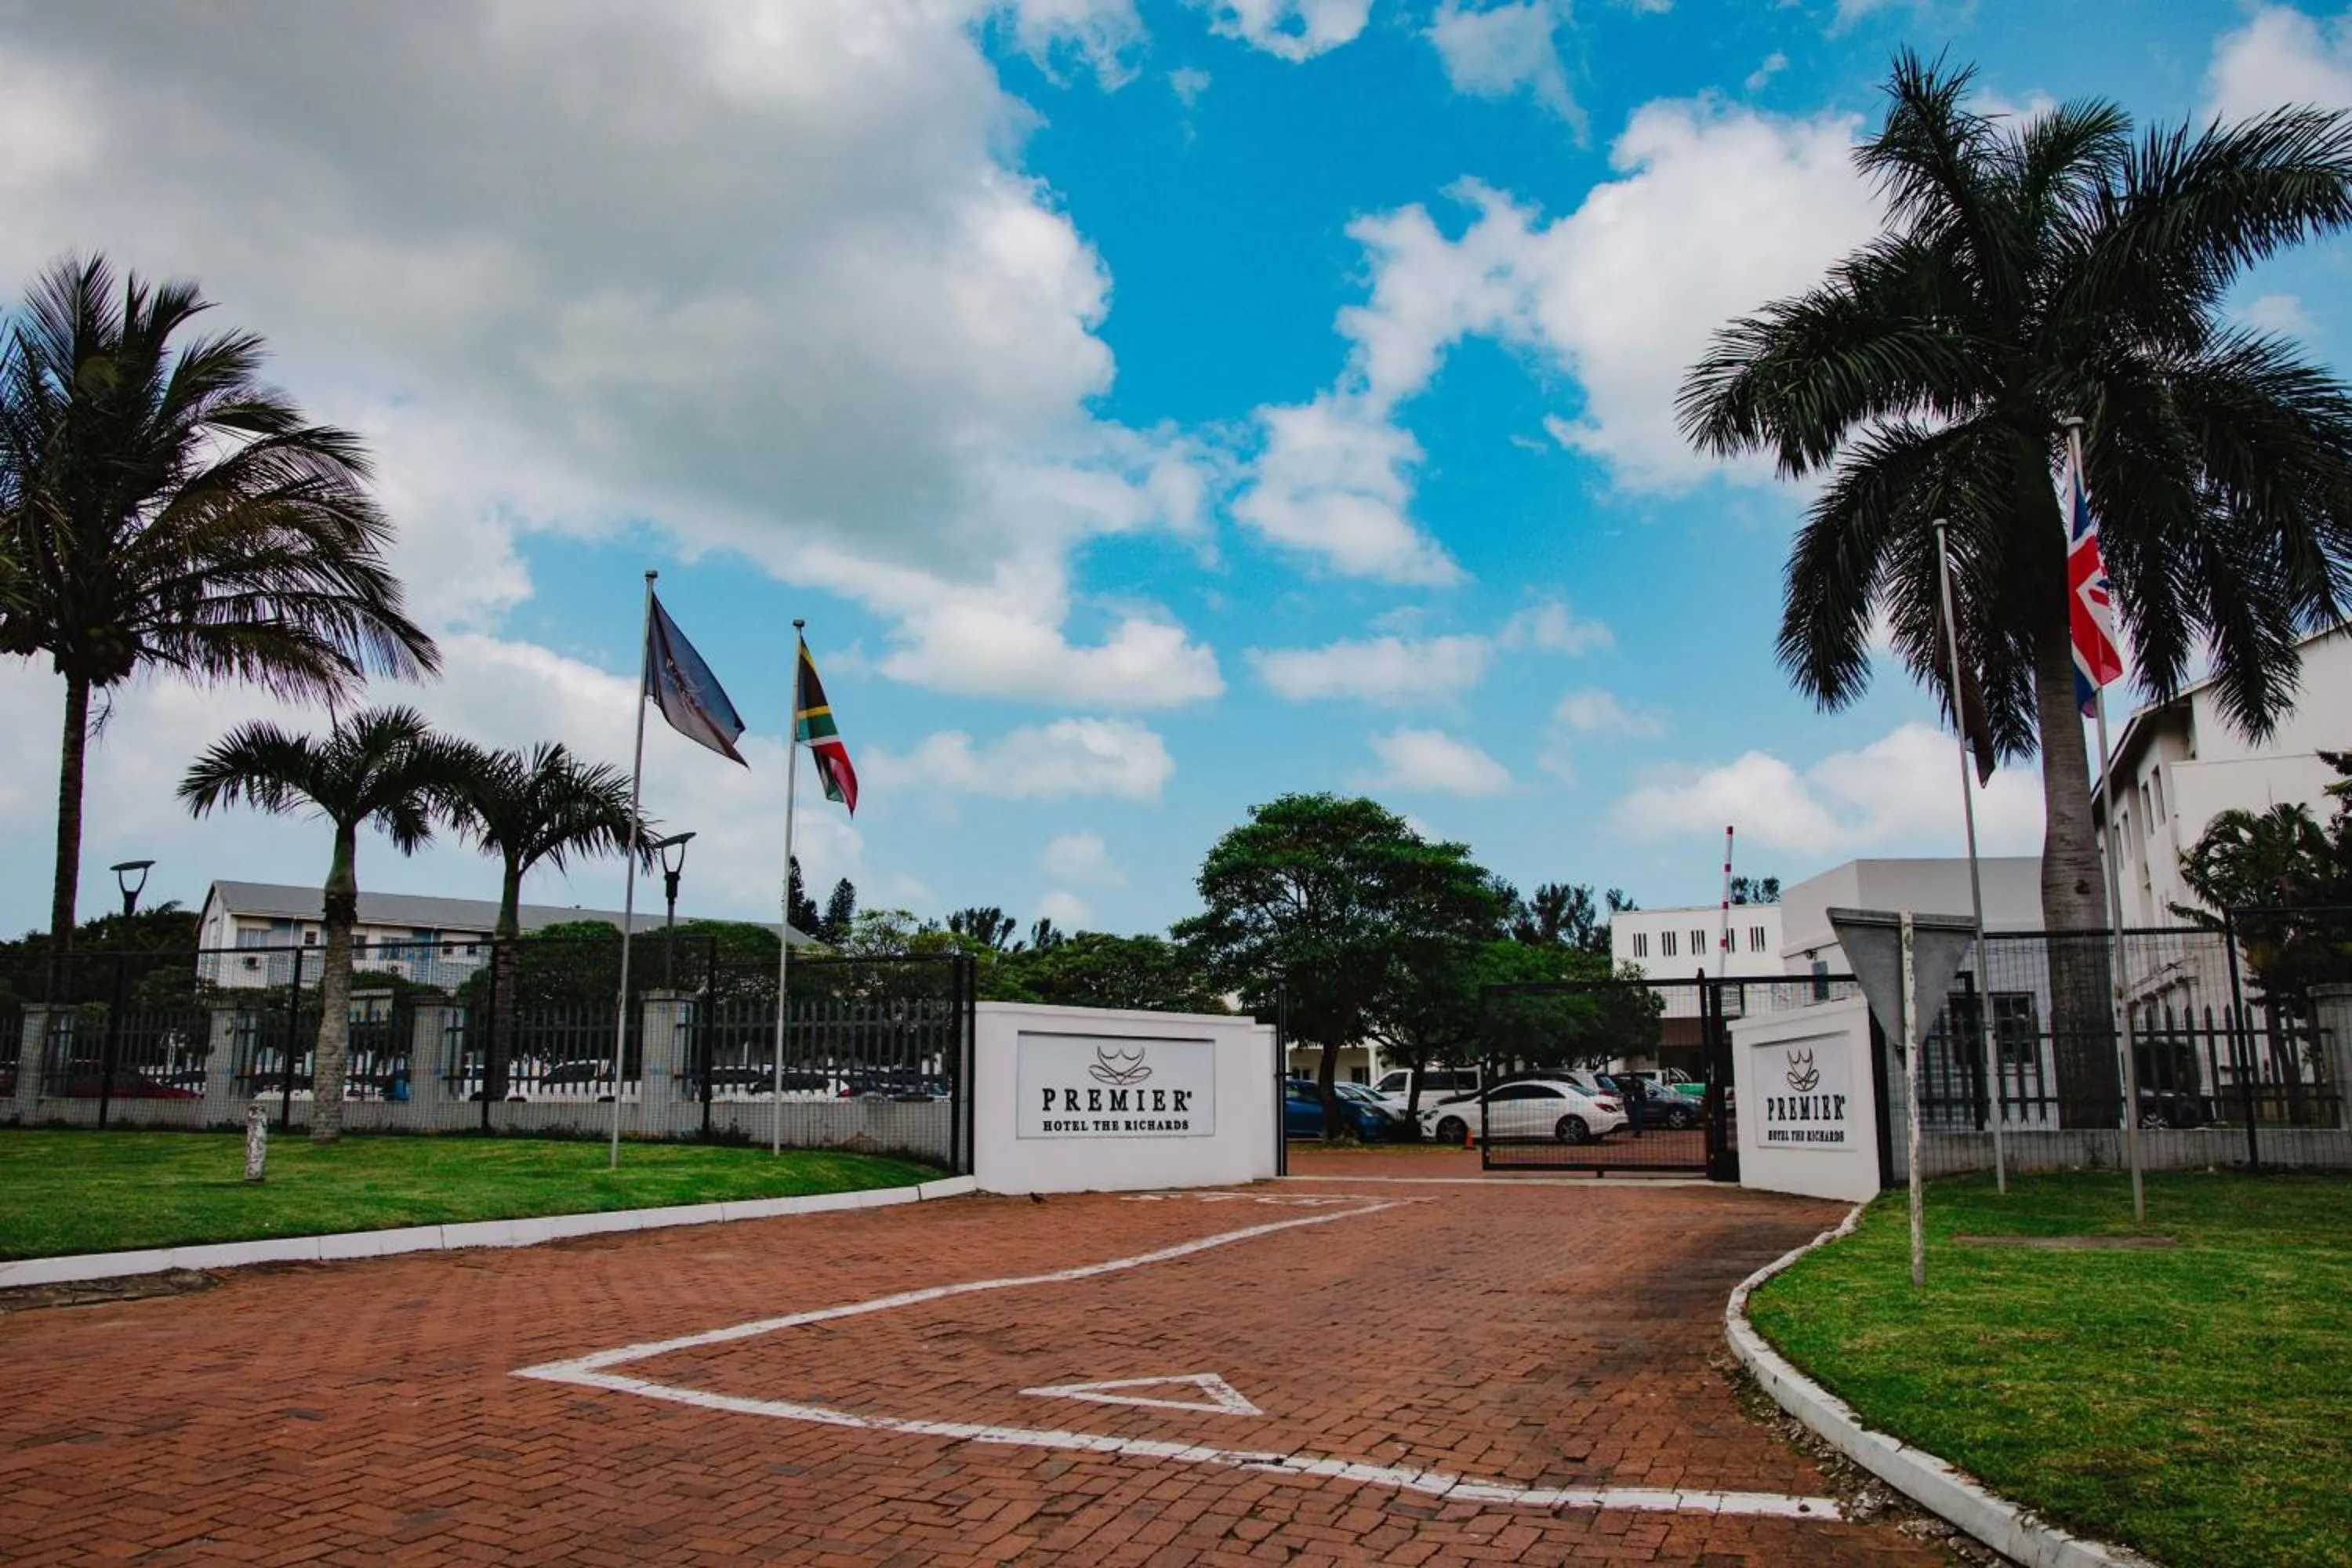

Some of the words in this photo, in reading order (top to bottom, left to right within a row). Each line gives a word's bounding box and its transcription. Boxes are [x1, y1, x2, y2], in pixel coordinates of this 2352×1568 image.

[1043, 1120, 1089, 1131] HOTEL
[1093, 1120, 1119, 1131] THE
[1124, 1120, 1189, 1131] RICHARDS
[1768, 1130, 1789, 1141] HOTEL
[1791, 1130, 1805, 1142] THE
[1806, 1130, 1845, 1142] RICHARDS
